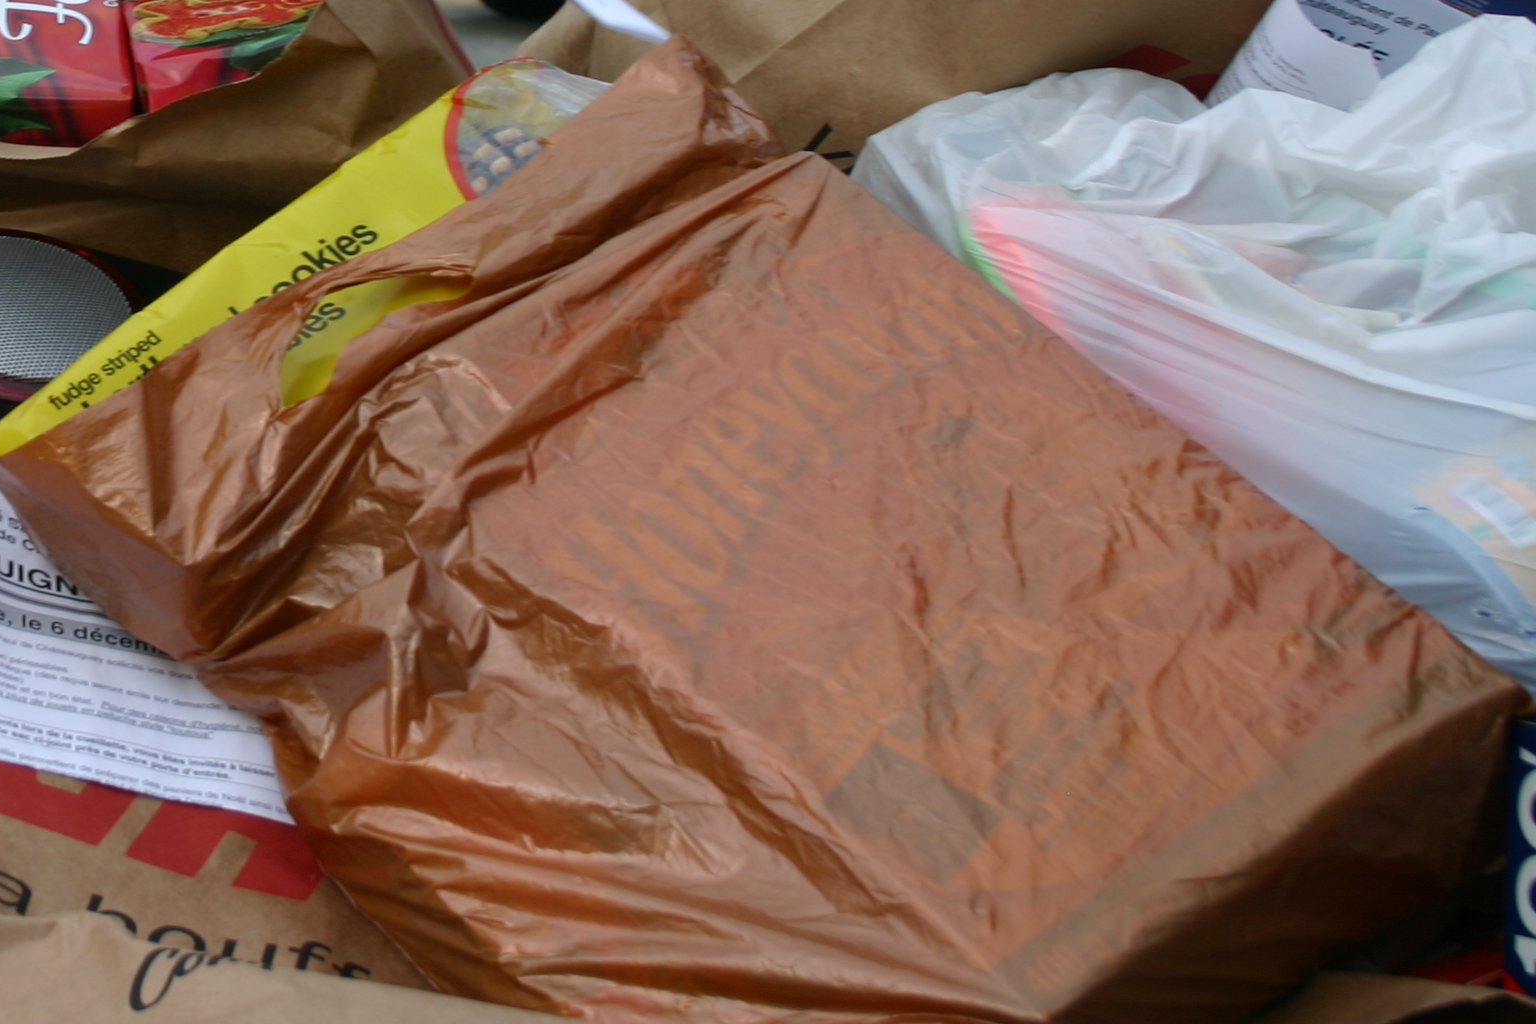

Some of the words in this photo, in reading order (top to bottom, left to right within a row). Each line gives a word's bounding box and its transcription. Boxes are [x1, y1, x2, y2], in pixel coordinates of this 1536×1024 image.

[48, 368, 101, 412] fudge
[101, 329, 163, 376] striped
[21, 613, 42, 631] le
[50, 621, 65, 635] 6
